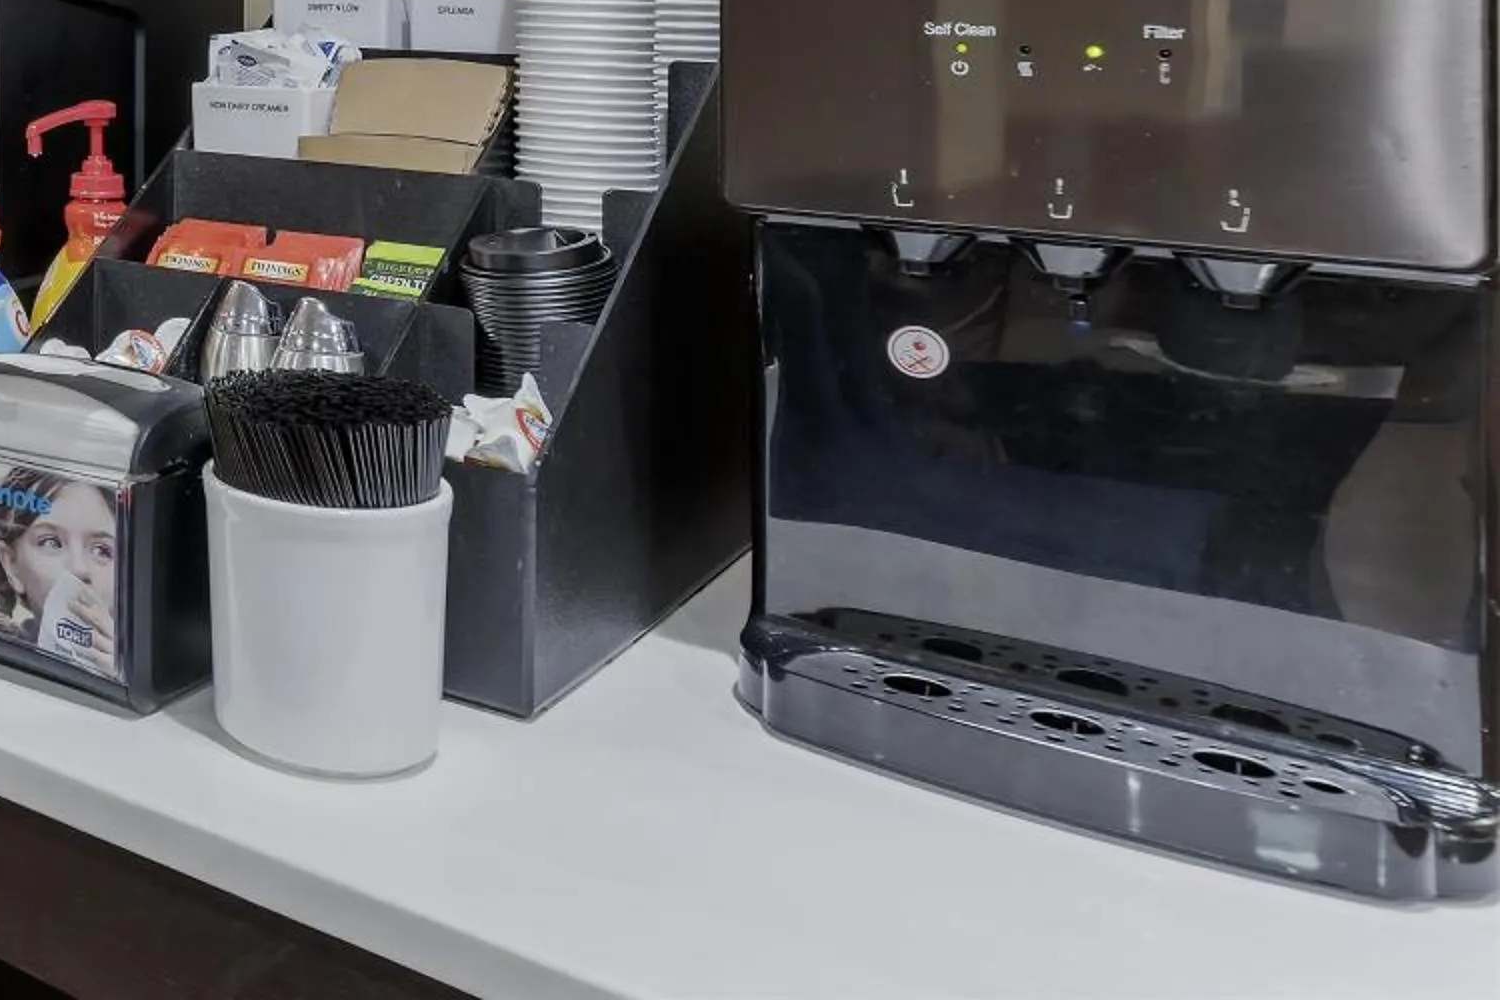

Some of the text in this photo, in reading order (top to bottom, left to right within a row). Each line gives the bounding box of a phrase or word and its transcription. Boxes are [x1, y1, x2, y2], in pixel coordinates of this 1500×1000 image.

[923, 22, 997, 37] Self Clean
[250, 262, 303, 277] TWININGS
